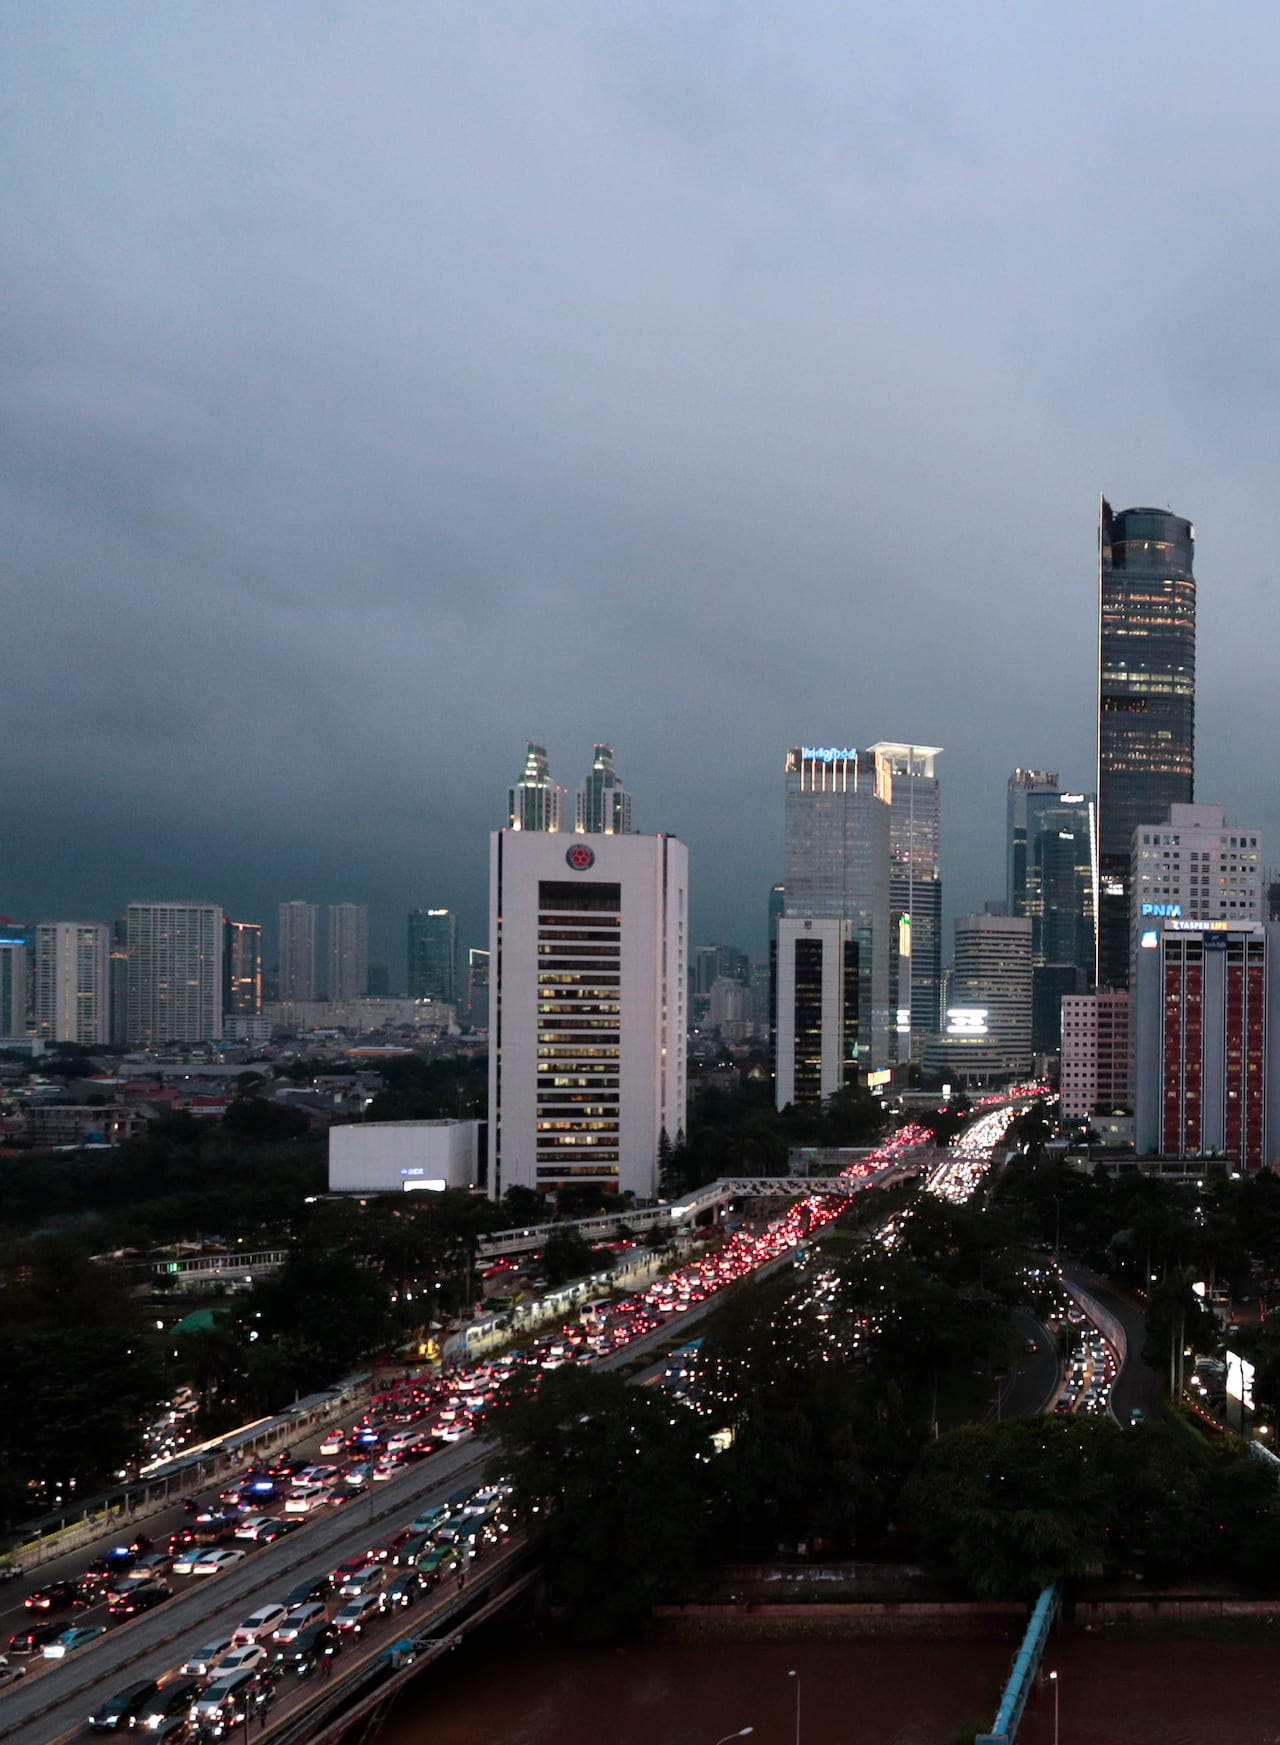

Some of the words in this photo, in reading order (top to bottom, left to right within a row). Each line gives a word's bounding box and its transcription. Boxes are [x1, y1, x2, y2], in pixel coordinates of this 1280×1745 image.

[804, 747, 857, 763] Indofood
[1142, 903, 1182, 917] PNM
[1179, 921, 1210, 930] TASPEN
[1210, 921, 1229, 930] LIFE
